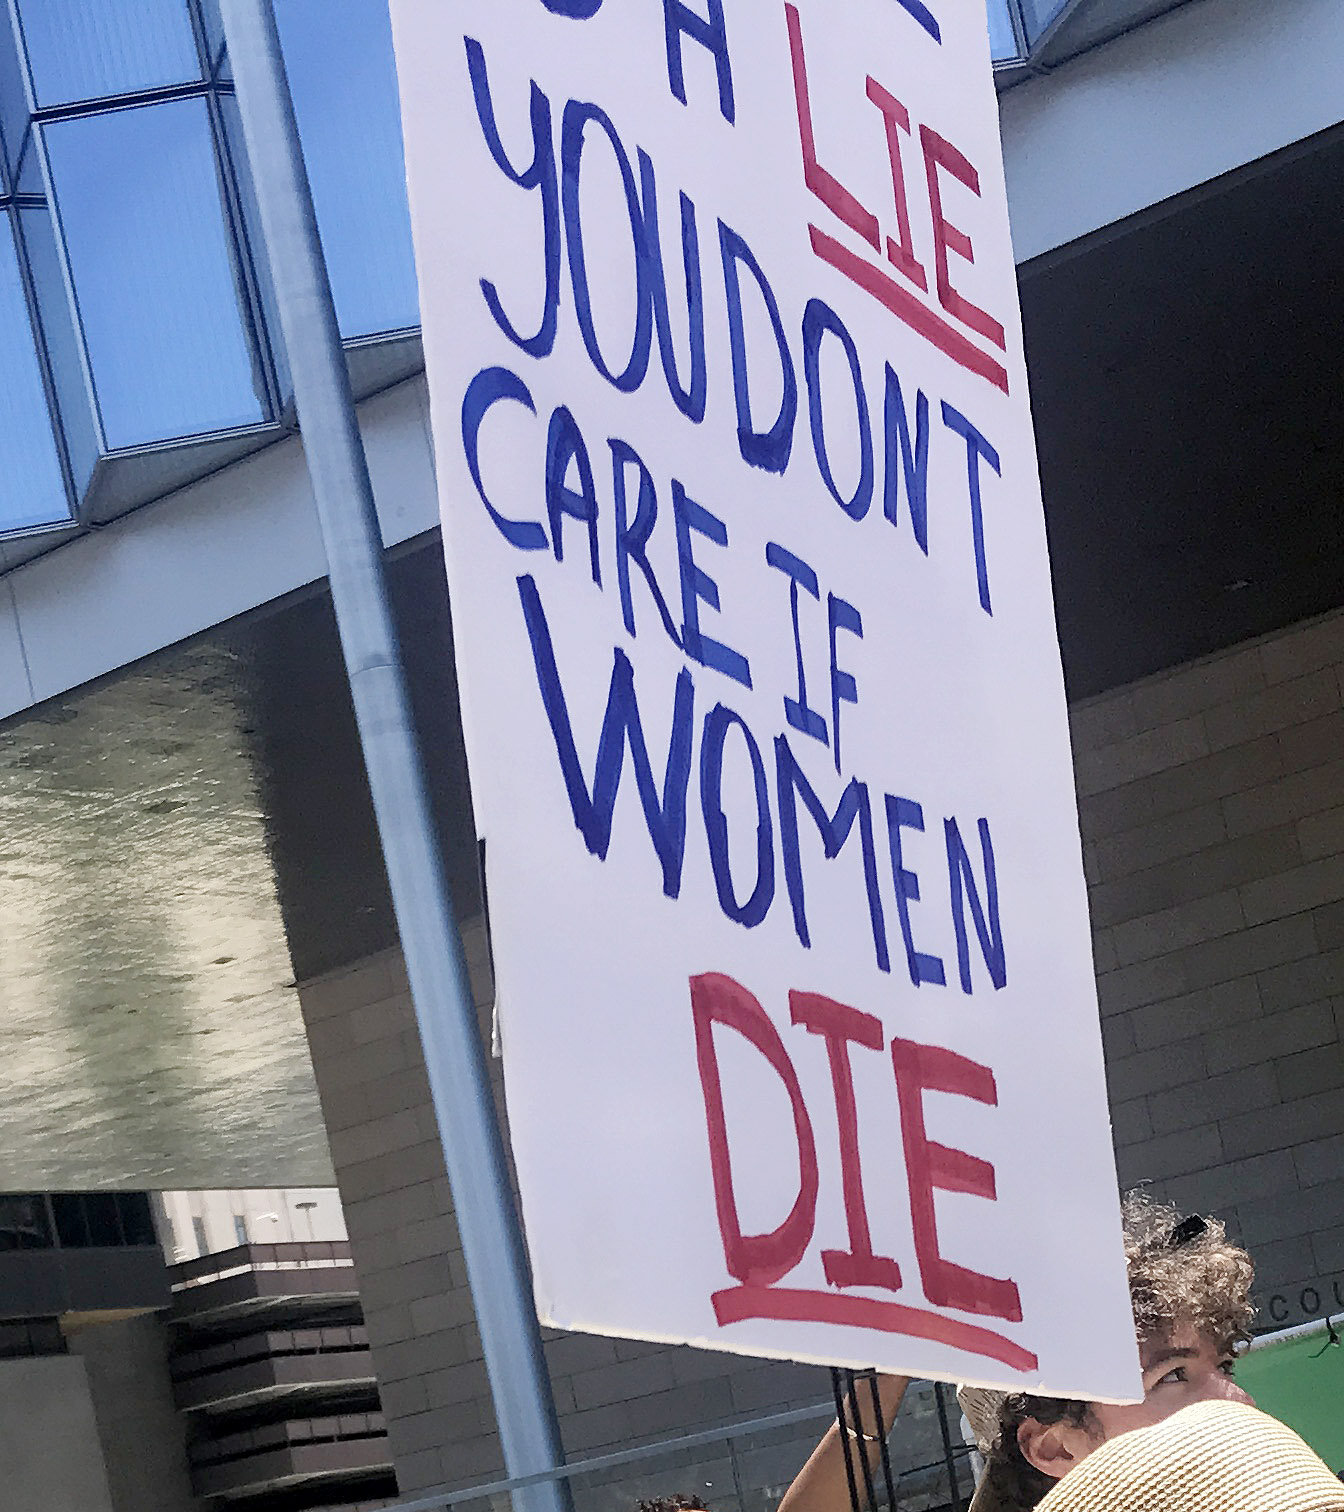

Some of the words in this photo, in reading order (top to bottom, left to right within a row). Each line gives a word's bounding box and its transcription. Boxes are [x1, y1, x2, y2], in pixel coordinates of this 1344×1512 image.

[463, 35, 707, 424] YOU
[717, 216, 1002, 618] DONT
[784, 2, 1008, 353] LIE
[460, 365, 753, 691] CARE
[765, 541, 864, 776] IF
[516, 573, 1007, 995] WOMEN
[689, 971, 1023, 1323] DIE
